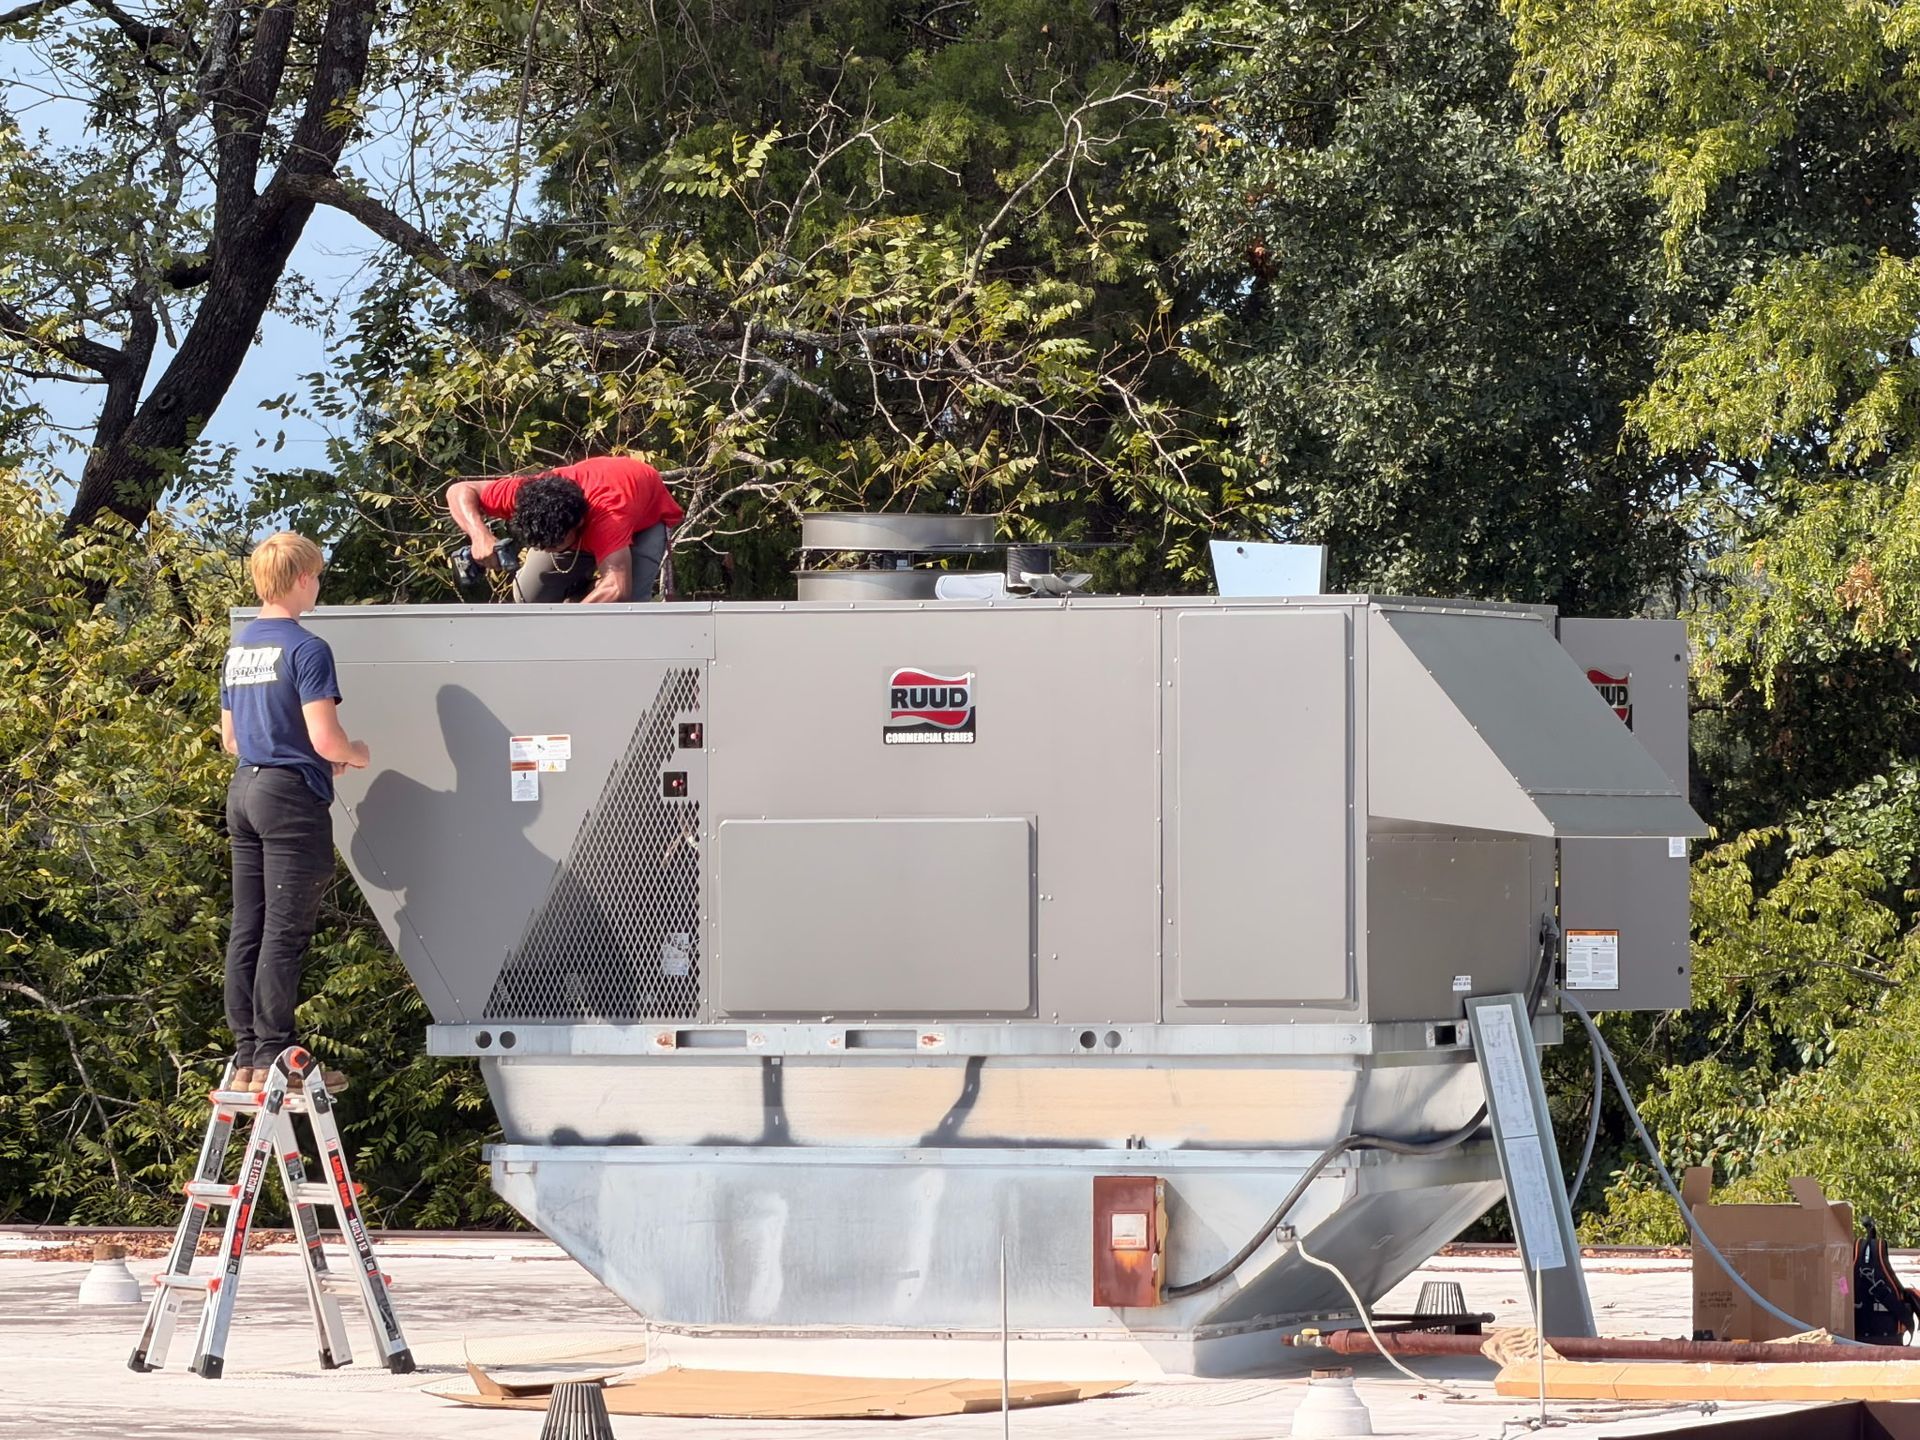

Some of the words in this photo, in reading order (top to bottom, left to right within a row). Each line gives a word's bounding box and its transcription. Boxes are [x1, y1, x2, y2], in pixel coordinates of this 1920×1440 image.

[891, 687, 968, 709] RUUD
[885, 732, 942, 744] COMMERCIAL
[943, 732, 974, 743] SERIES
